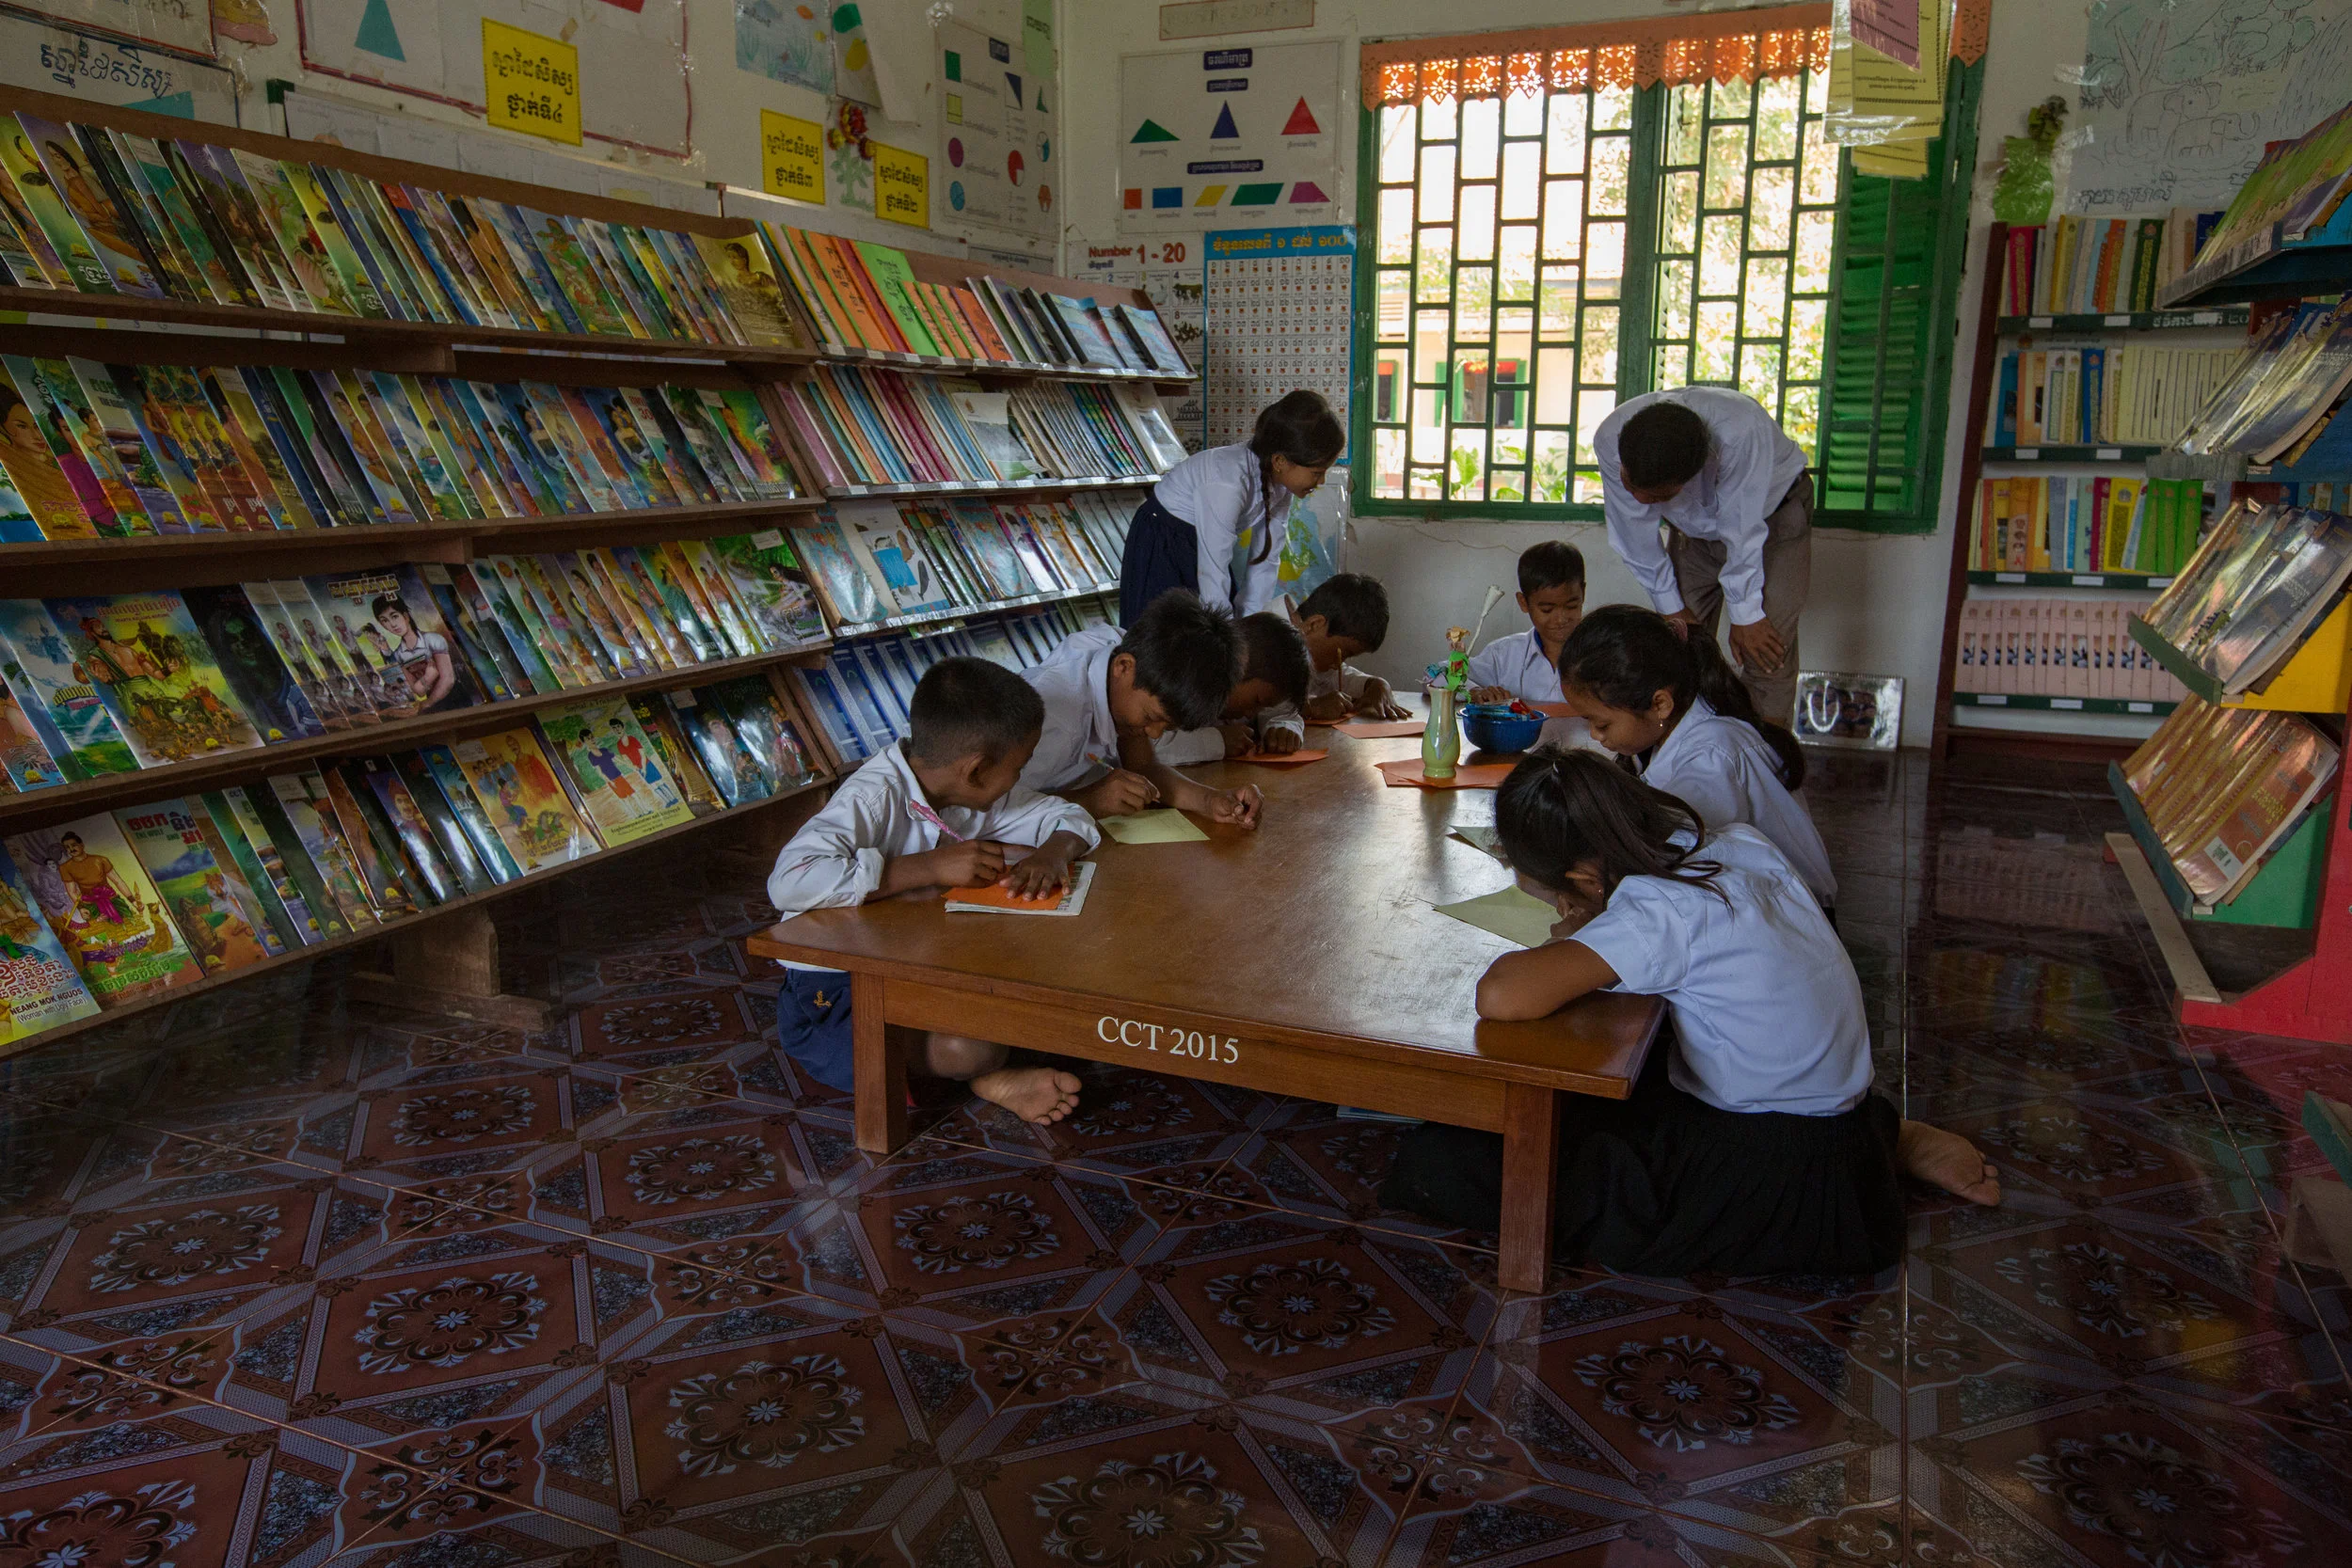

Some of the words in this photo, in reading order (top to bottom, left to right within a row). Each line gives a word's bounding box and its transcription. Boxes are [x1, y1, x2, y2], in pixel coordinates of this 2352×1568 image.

[1088, 244, 1134, 261] Number
[1136, 244, 1146, 264] 1
[1163, 242, 1186, 263] 20
[9, 1001, 40, 1016] NEANG
[40, 994, 57, 1007] MOK
[57, 988, 84, 1002] NGUOS
[16, 1009, 46, 1023] (Woman
[69, 995, 87, 1009] Face)
[1097, 1016, 1164, 1052] CCT
[1168, 1028, 1239, 1064] 2015
